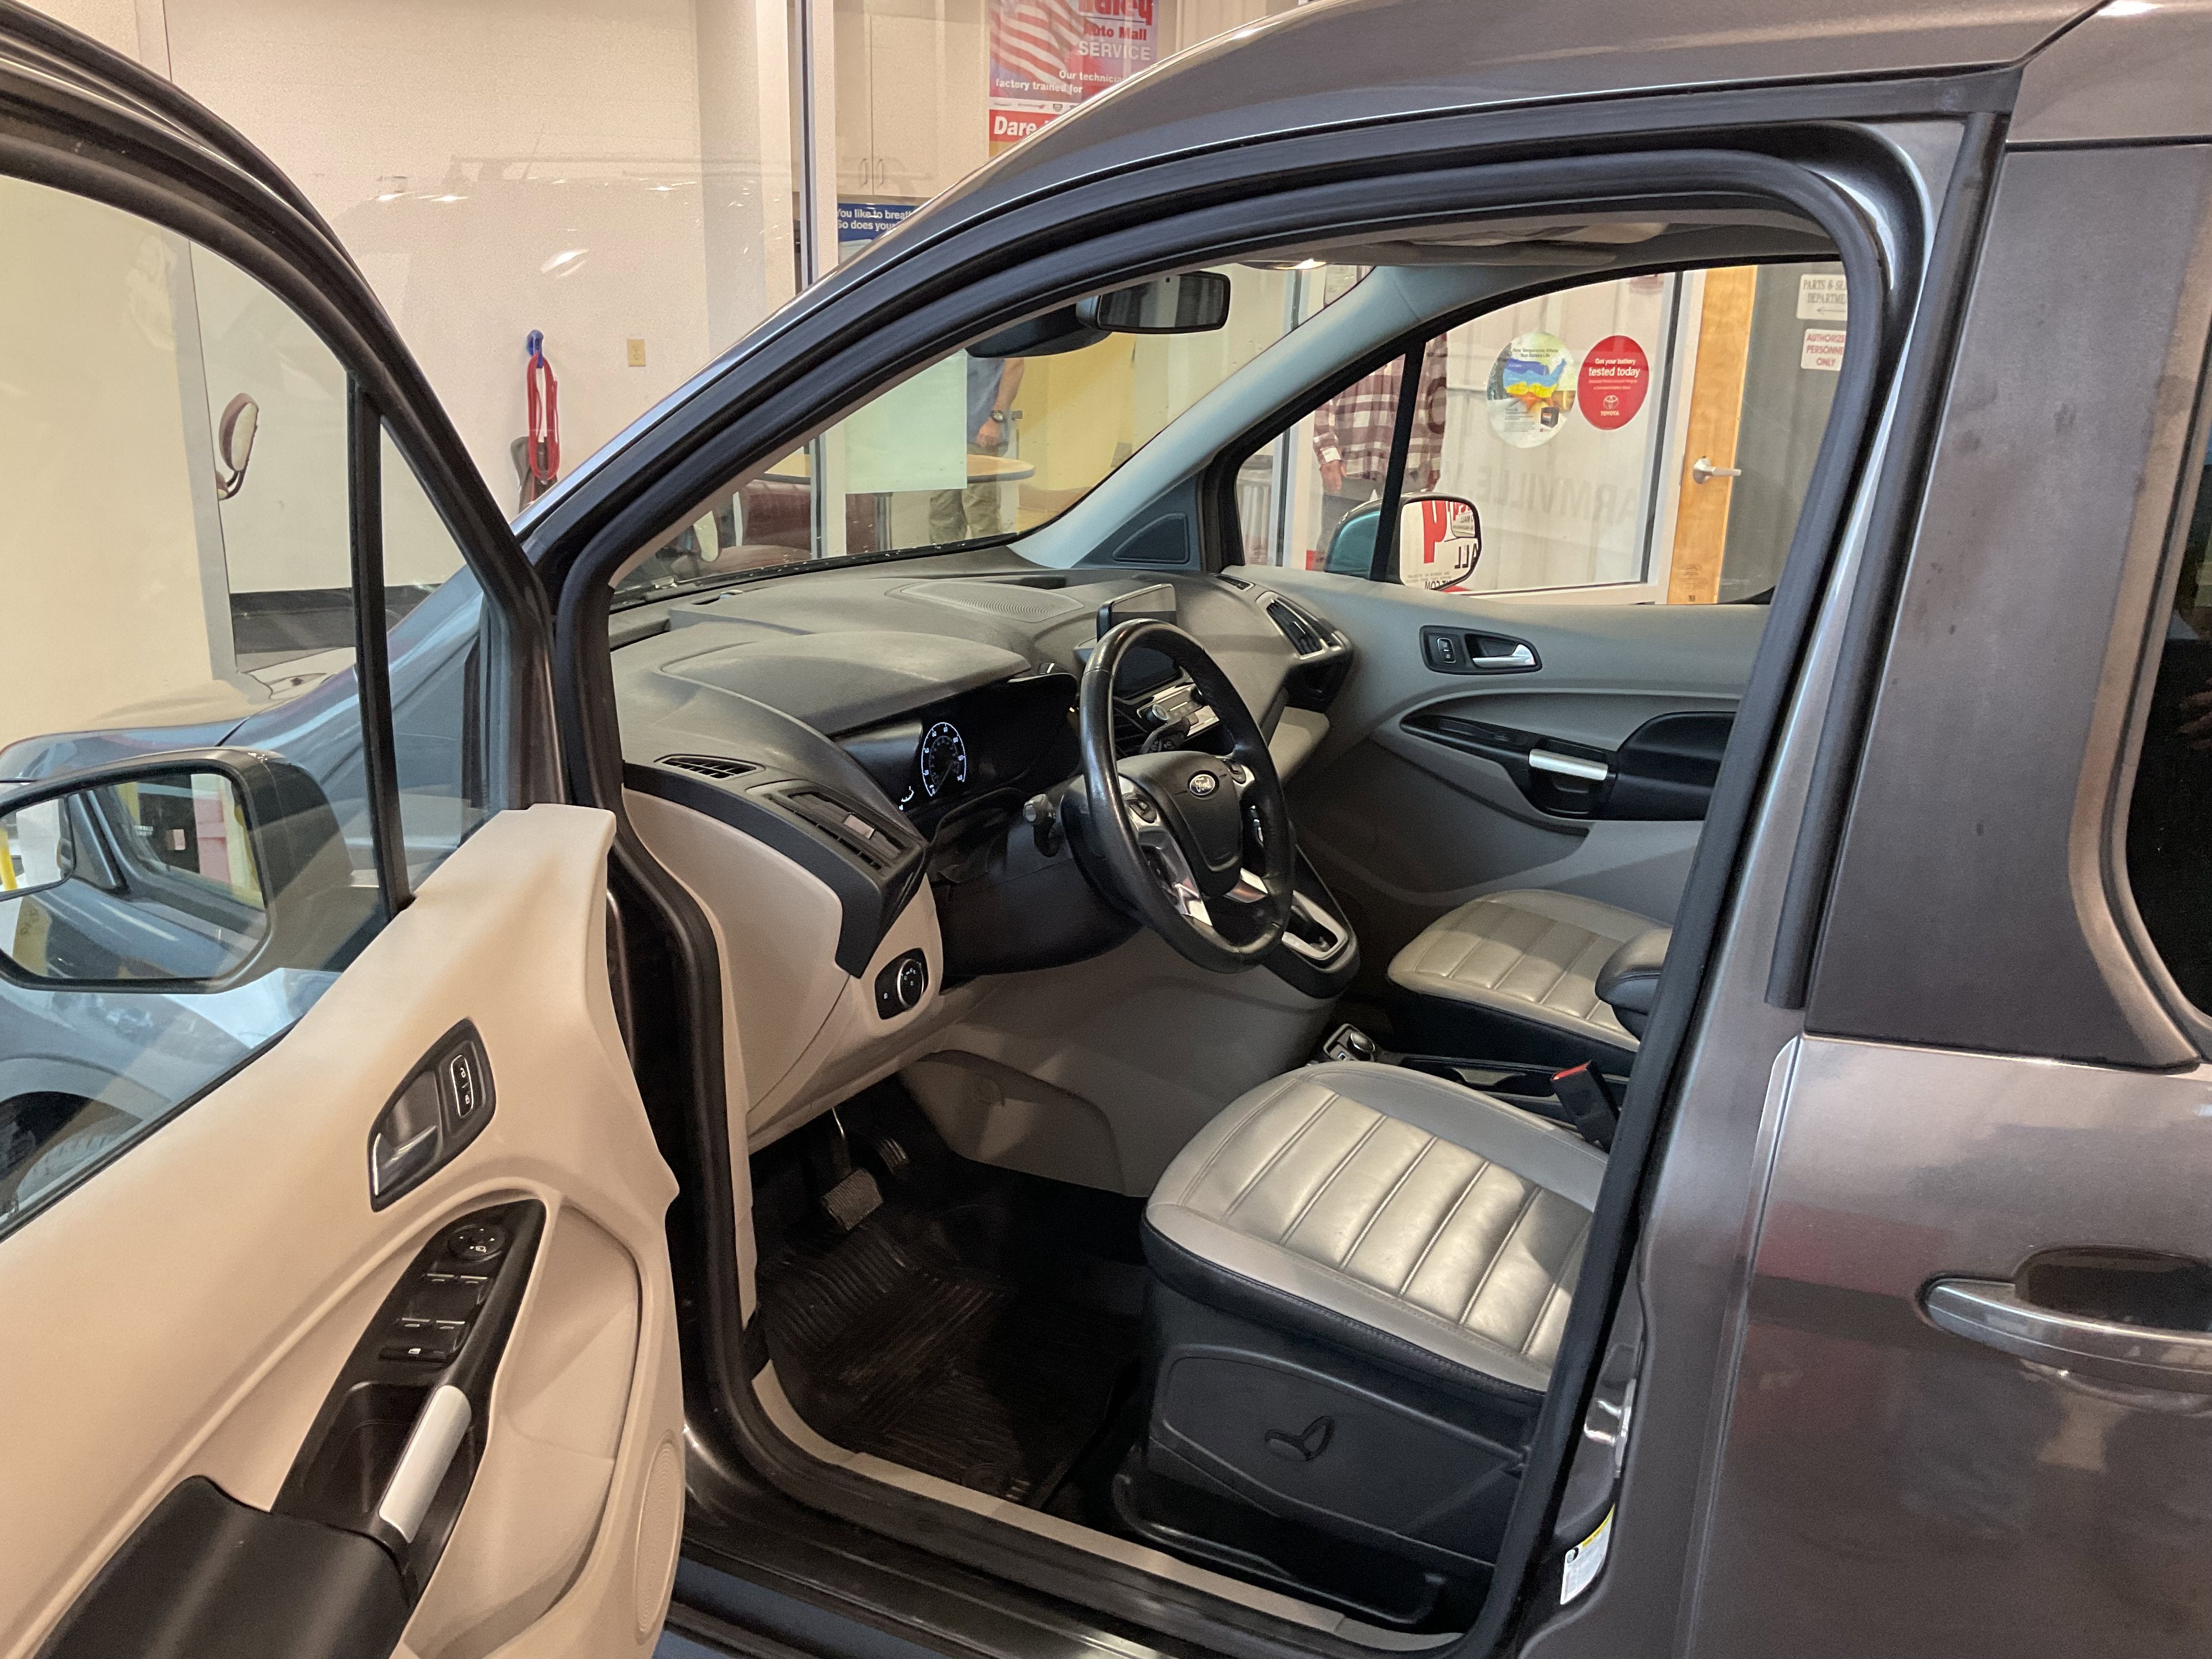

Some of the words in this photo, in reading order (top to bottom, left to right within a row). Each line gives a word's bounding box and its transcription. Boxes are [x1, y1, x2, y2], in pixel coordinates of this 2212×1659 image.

[1084, 26, 1114, 38] Auto
[1119, 27, 1147, 41] Mall
[1078, 41, 1150, 60] SERVICE
[1059, 70, 1076, 80] Our
[996, 78, 1029, 91] factory
[1032, 81, 1066, 92] trained
[1069, 83, 1083, 94] for
[994, 116, 1037, 136] Dare
[854, 208, 871, 218] like
[873, 210, 882, 219] to
[838, 220, 848, 229] So
[851, 221, 873, 229] does
[1803, 280, 1826, 290] PARTS
[1835, 281, 1846, 291] SE
[1816, 358, 1835, 366] ONLY
[1589, 367, 1615, 376] tested
[1617, 367, 1640, 378] today
[1195, 777, 1211, 792] Ford
